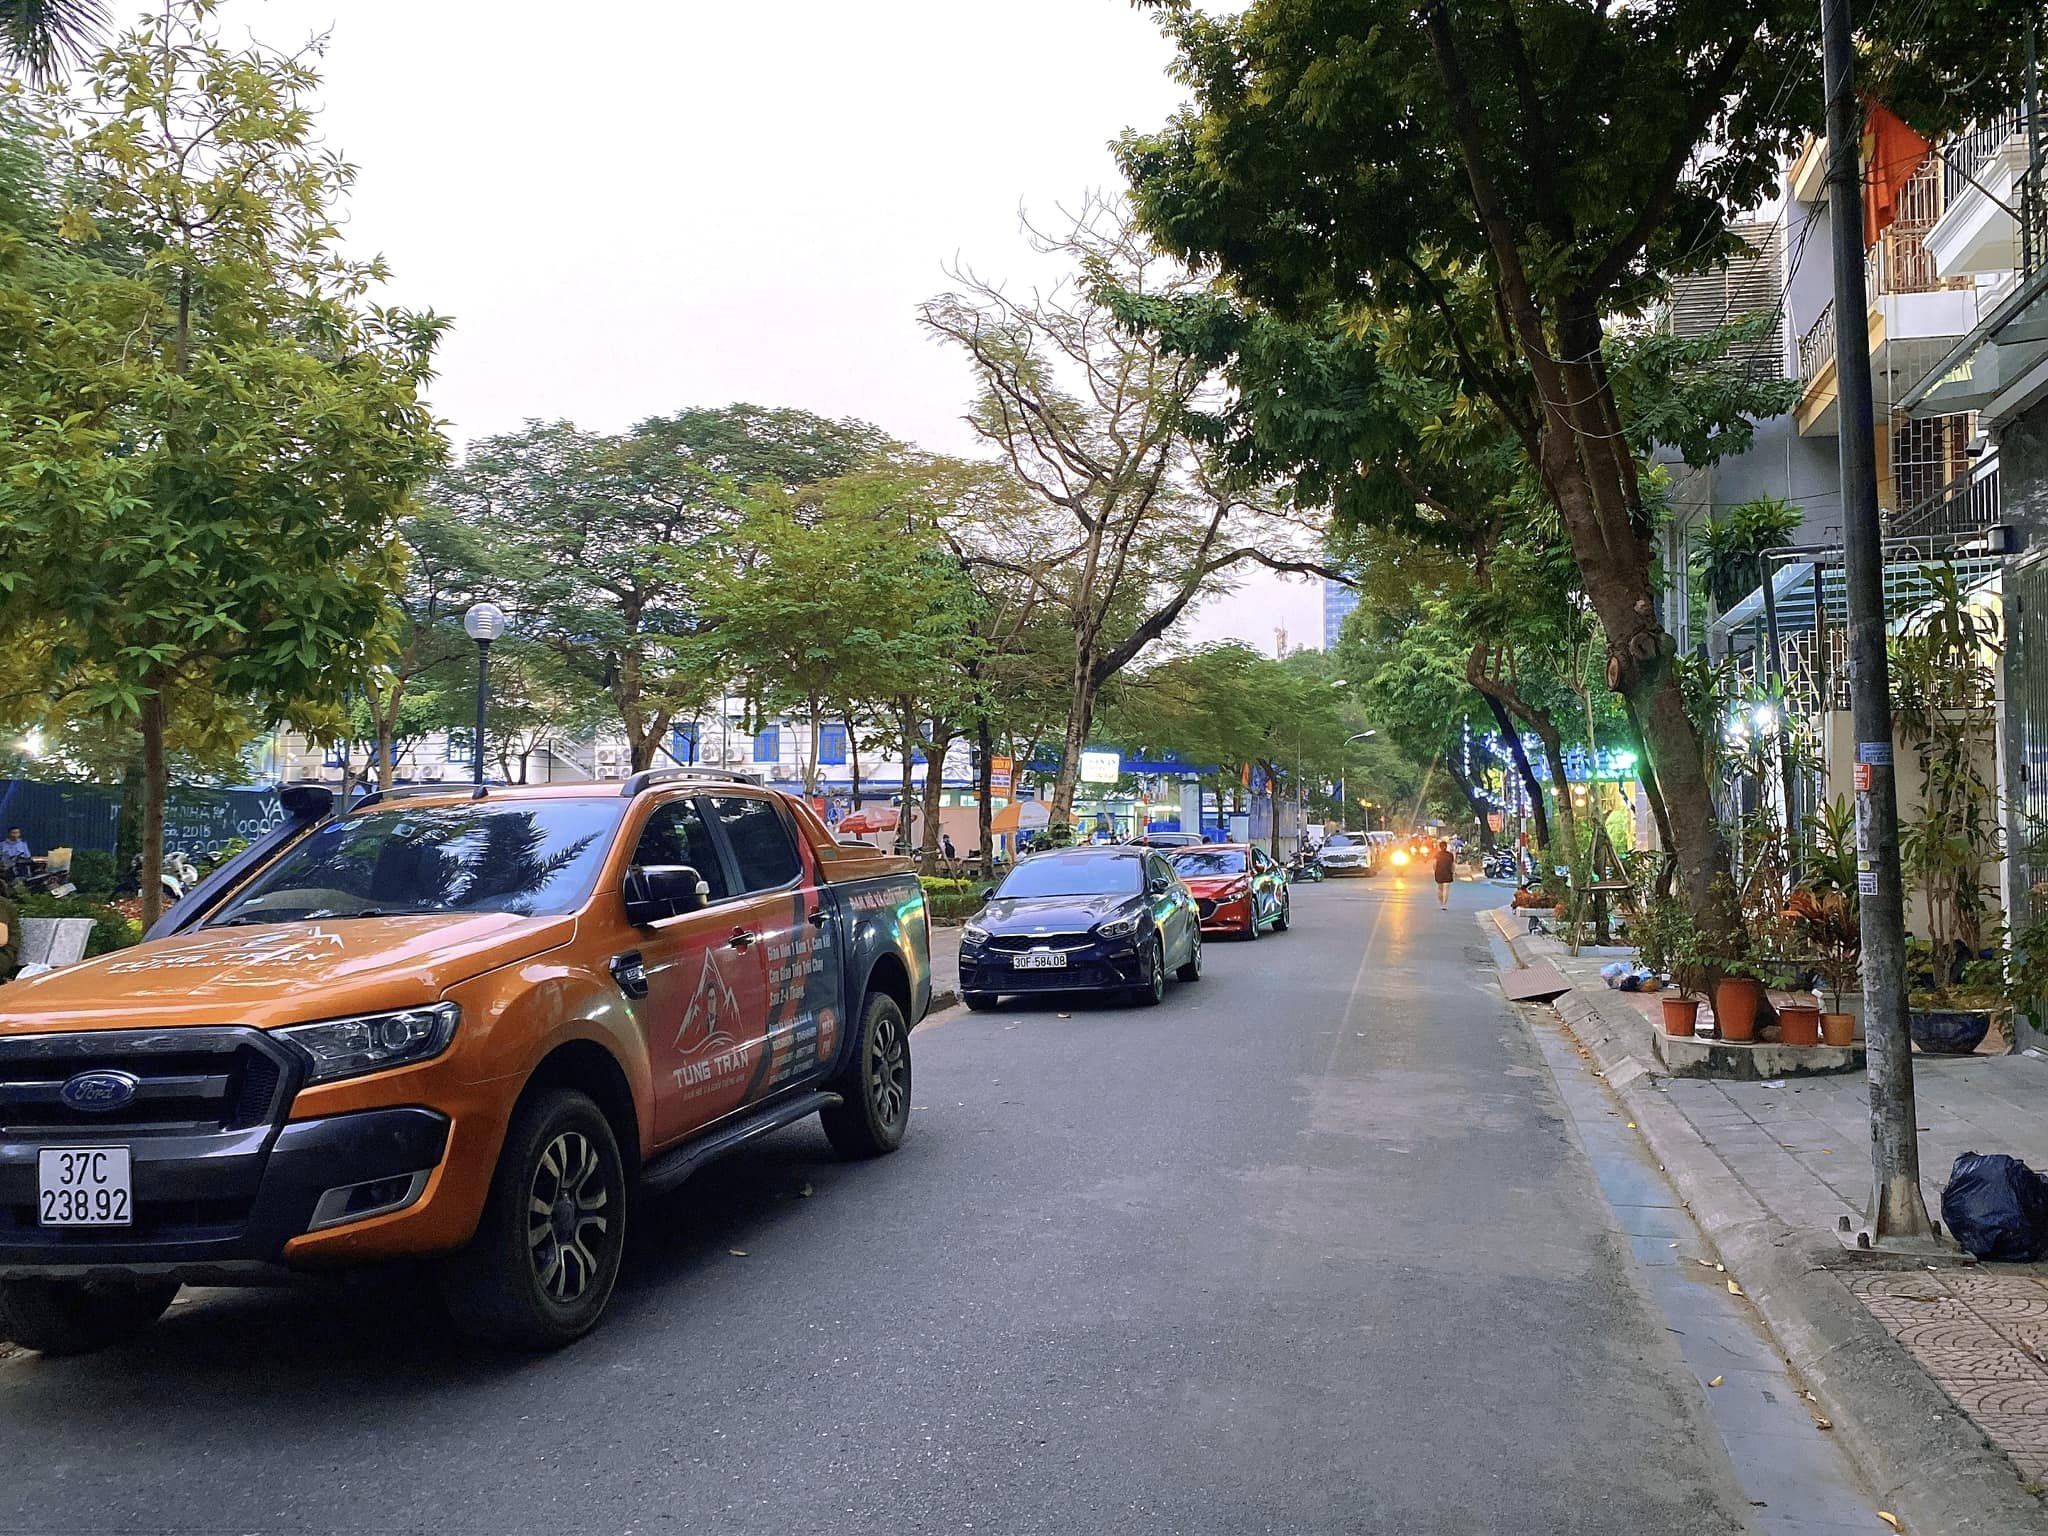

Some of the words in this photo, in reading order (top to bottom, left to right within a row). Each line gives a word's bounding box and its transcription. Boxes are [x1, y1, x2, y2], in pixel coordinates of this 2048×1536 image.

[672, 1059, 712, 1089] TÙNG
[75, 1080, 115, 1101] Ford
[60, 1152, 107, 1185] 37C
[42, 1188, 129, 1221] 238.92
